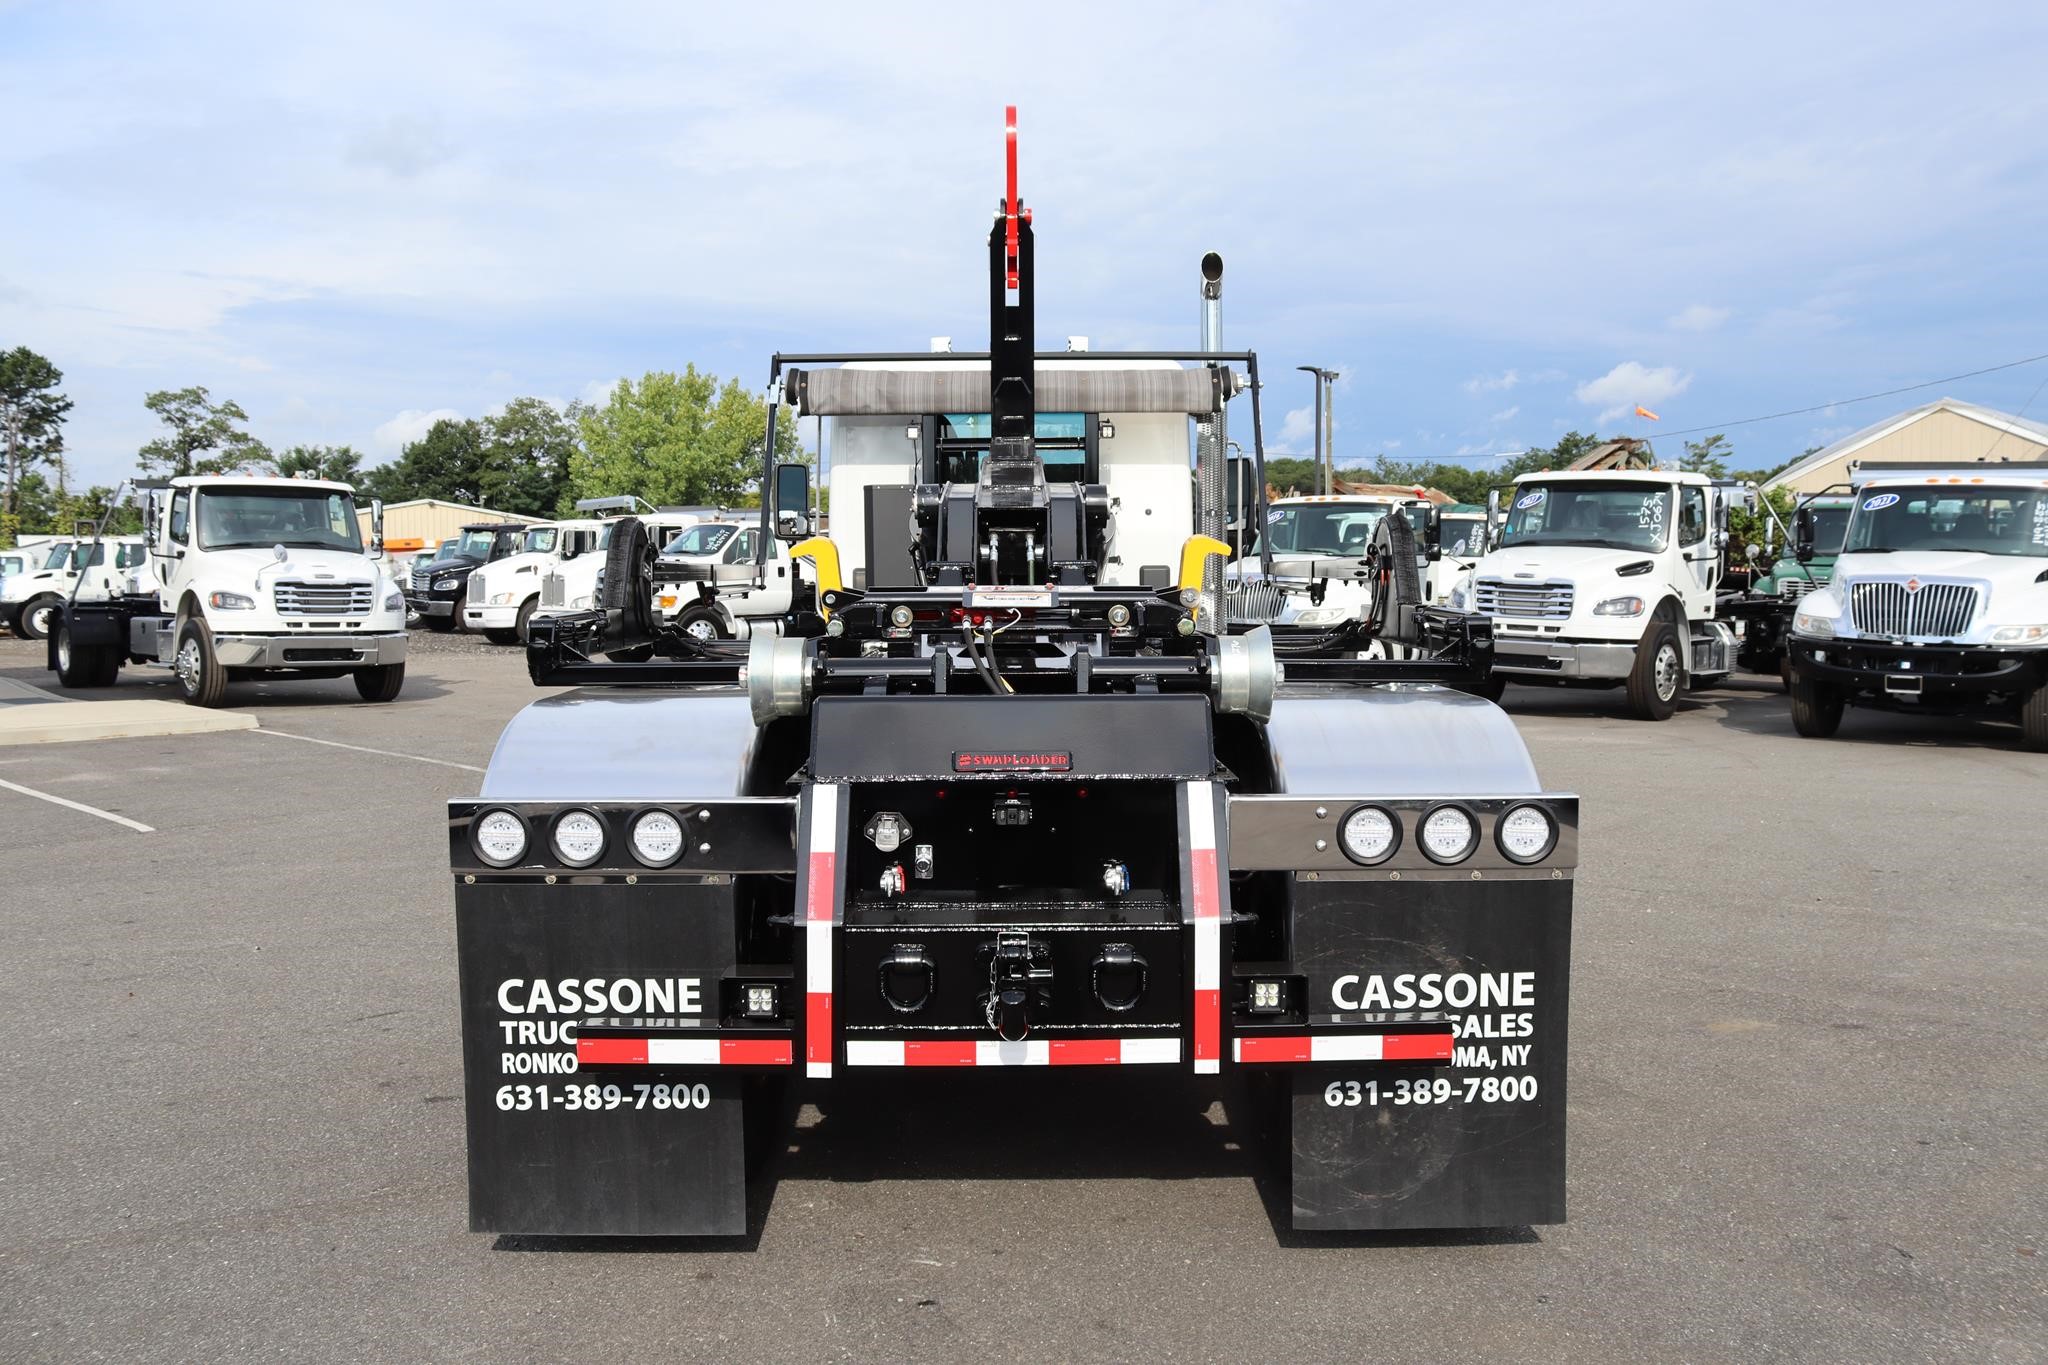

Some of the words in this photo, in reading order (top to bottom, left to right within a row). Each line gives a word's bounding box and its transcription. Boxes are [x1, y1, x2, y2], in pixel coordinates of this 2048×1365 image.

[1638, 496, 1652, 529] 1575
[973, 754, 1068, 766] SWAPLOADER
[497, 978, 702, 1014] CASSONE
[1331, 972, 1535, 1010] CASSONE
[499, 1020, 579, 1045] TRUC
[501, 1052, 579, 1075] RONKO
[1451, 1045, 1498, 1070] MA,
[1501, 1044, 1532, 1067] NY
[495, 1083, 711, 1111] 631-389-7800
[1324, 1075, 1538, 1107] 631-389-7800
